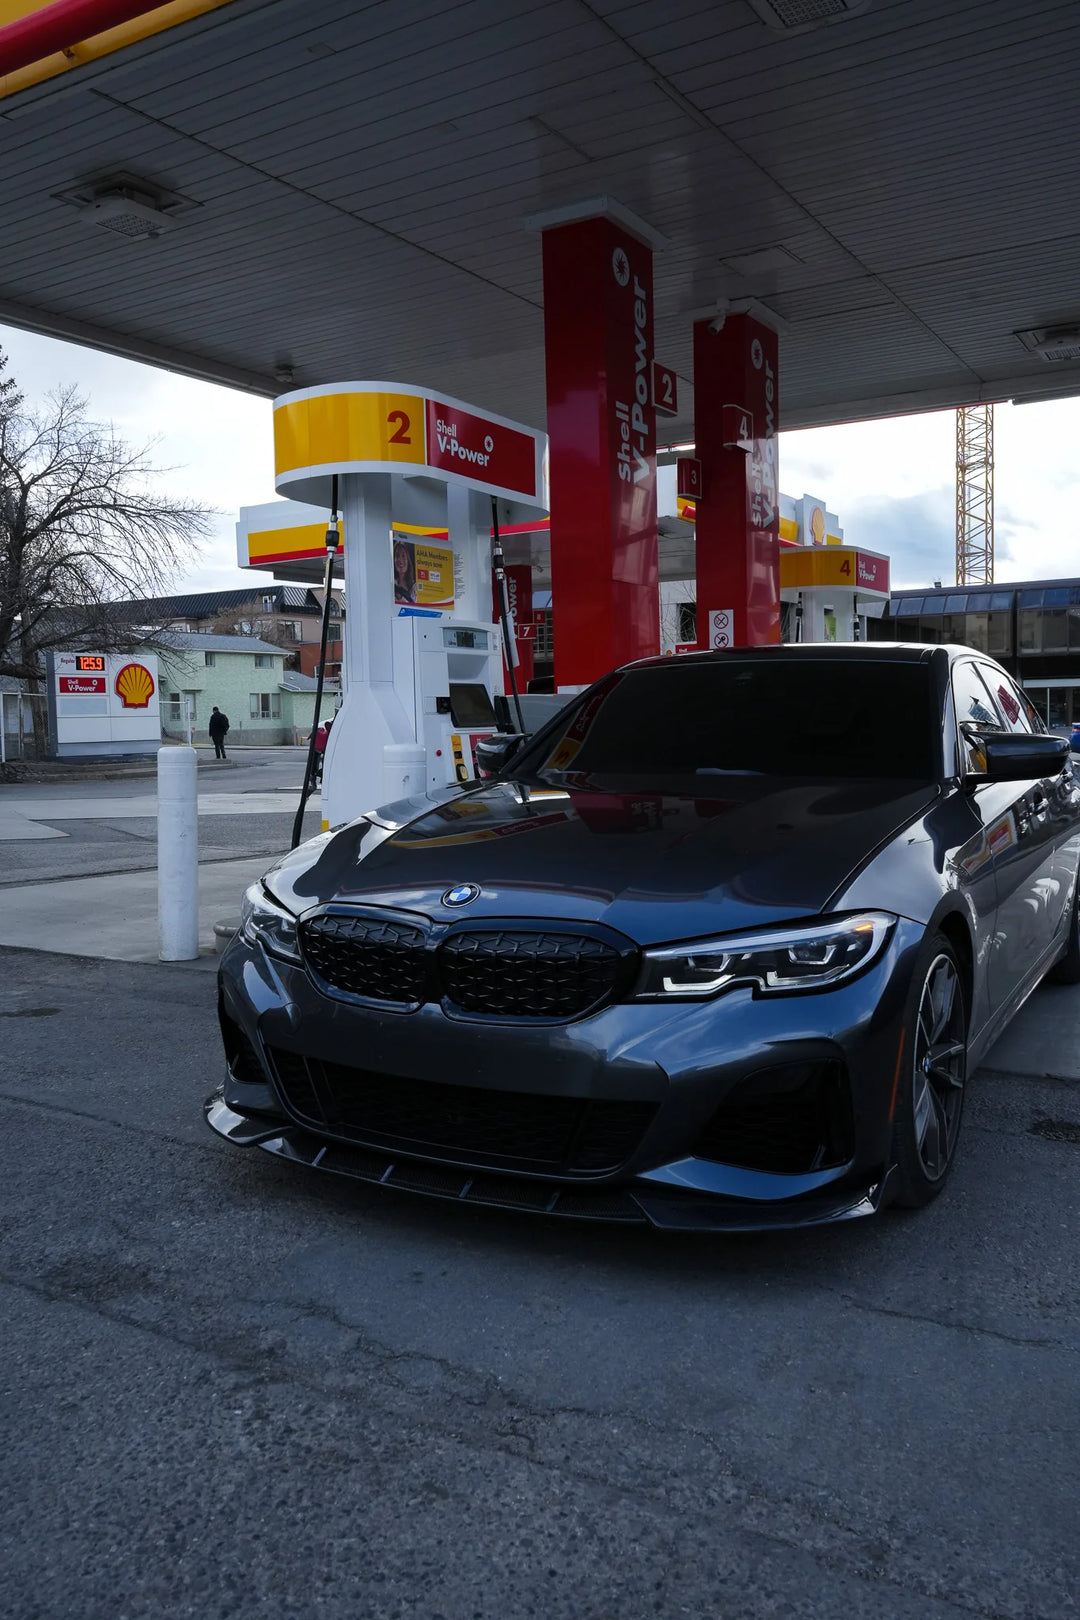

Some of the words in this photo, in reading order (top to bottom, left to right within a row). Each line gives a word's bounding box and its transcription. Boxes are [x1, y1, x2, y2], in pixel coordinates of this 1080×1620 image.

[633, 275, 650, 484] V-Power
[662, 373, 673, 404] 2
[386, 410, 411, 445] 2
[436, 418, 457, 438] Shell
[615, 400, 632, 483] Shell
[739, 416, 748, 440] 4
[436, 434, 490, 467] V-Power
[760, 359, 776, 528] V-Power
[691, 470, 697, 485] 3
[840, 560, 851, 576] 4
[524, 626, 530, 636] 7
